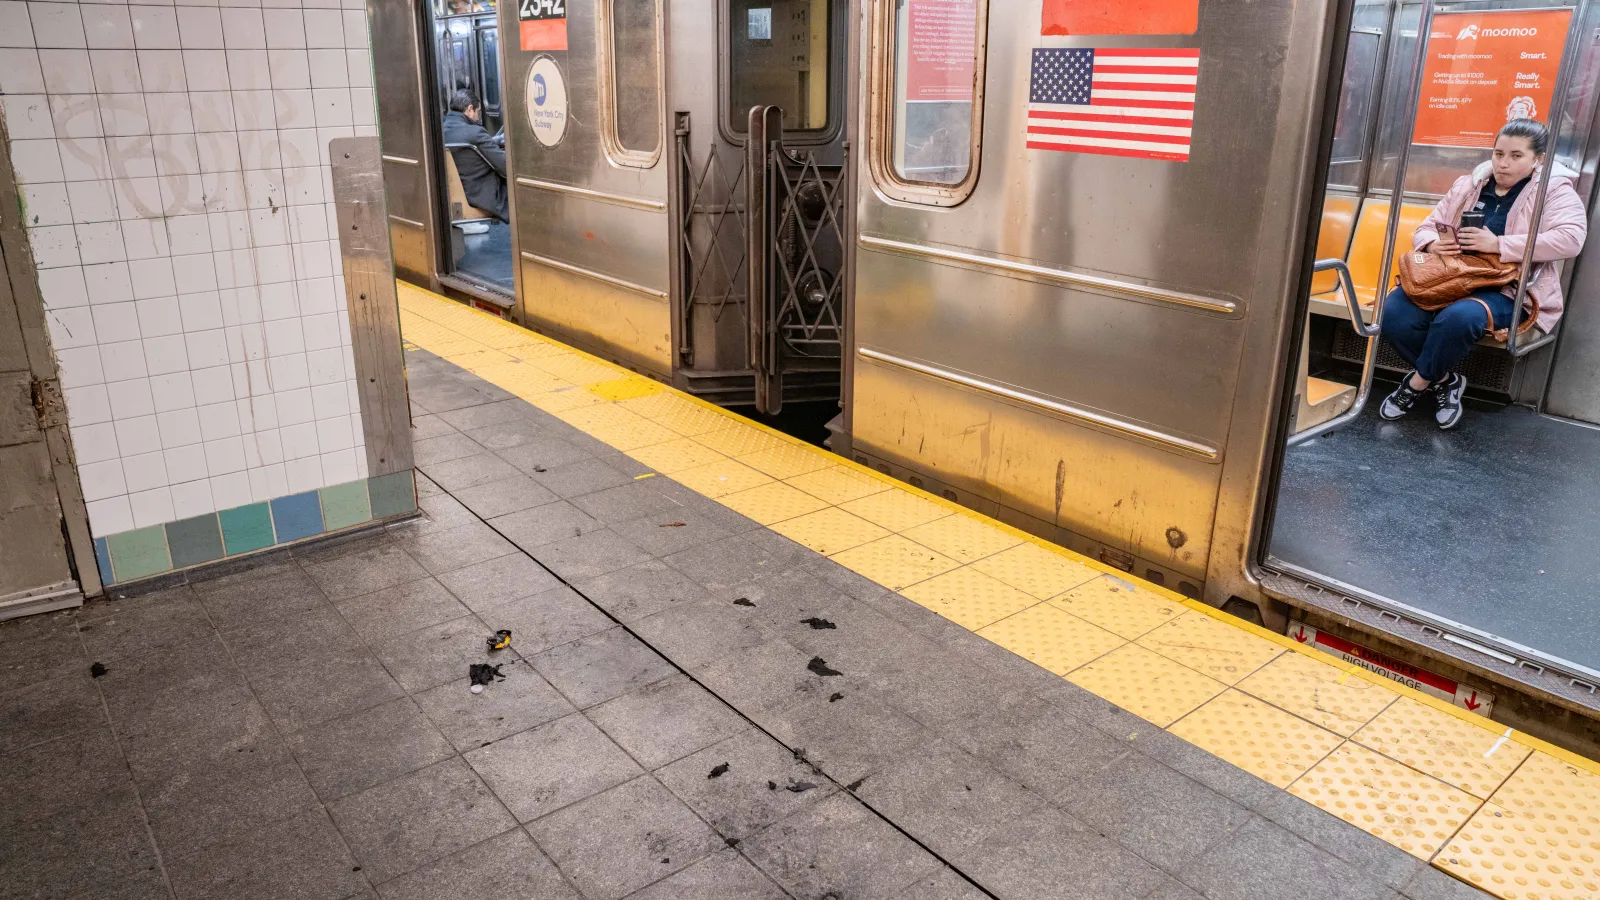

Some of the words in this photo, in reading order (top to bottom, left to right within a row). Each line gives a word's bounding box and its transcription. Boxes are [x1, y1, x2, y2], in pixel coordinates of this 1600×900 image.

[1481, 27, 1537, 37] moomoo
[1520, 51, 1547, 59] Smart.
[1516, 72, 1540, 81] Really
[1514, 81, 1540, 89] Smart.
[534, 109, 543, 117] New
[544, 110, 554, 118] York
[554, 110, 564, 121] City
[534, 119, 552, 131] Subway
[1342, 653, 1369, 670] HIGH
[1362, 650, 1419, 678] DANGER
